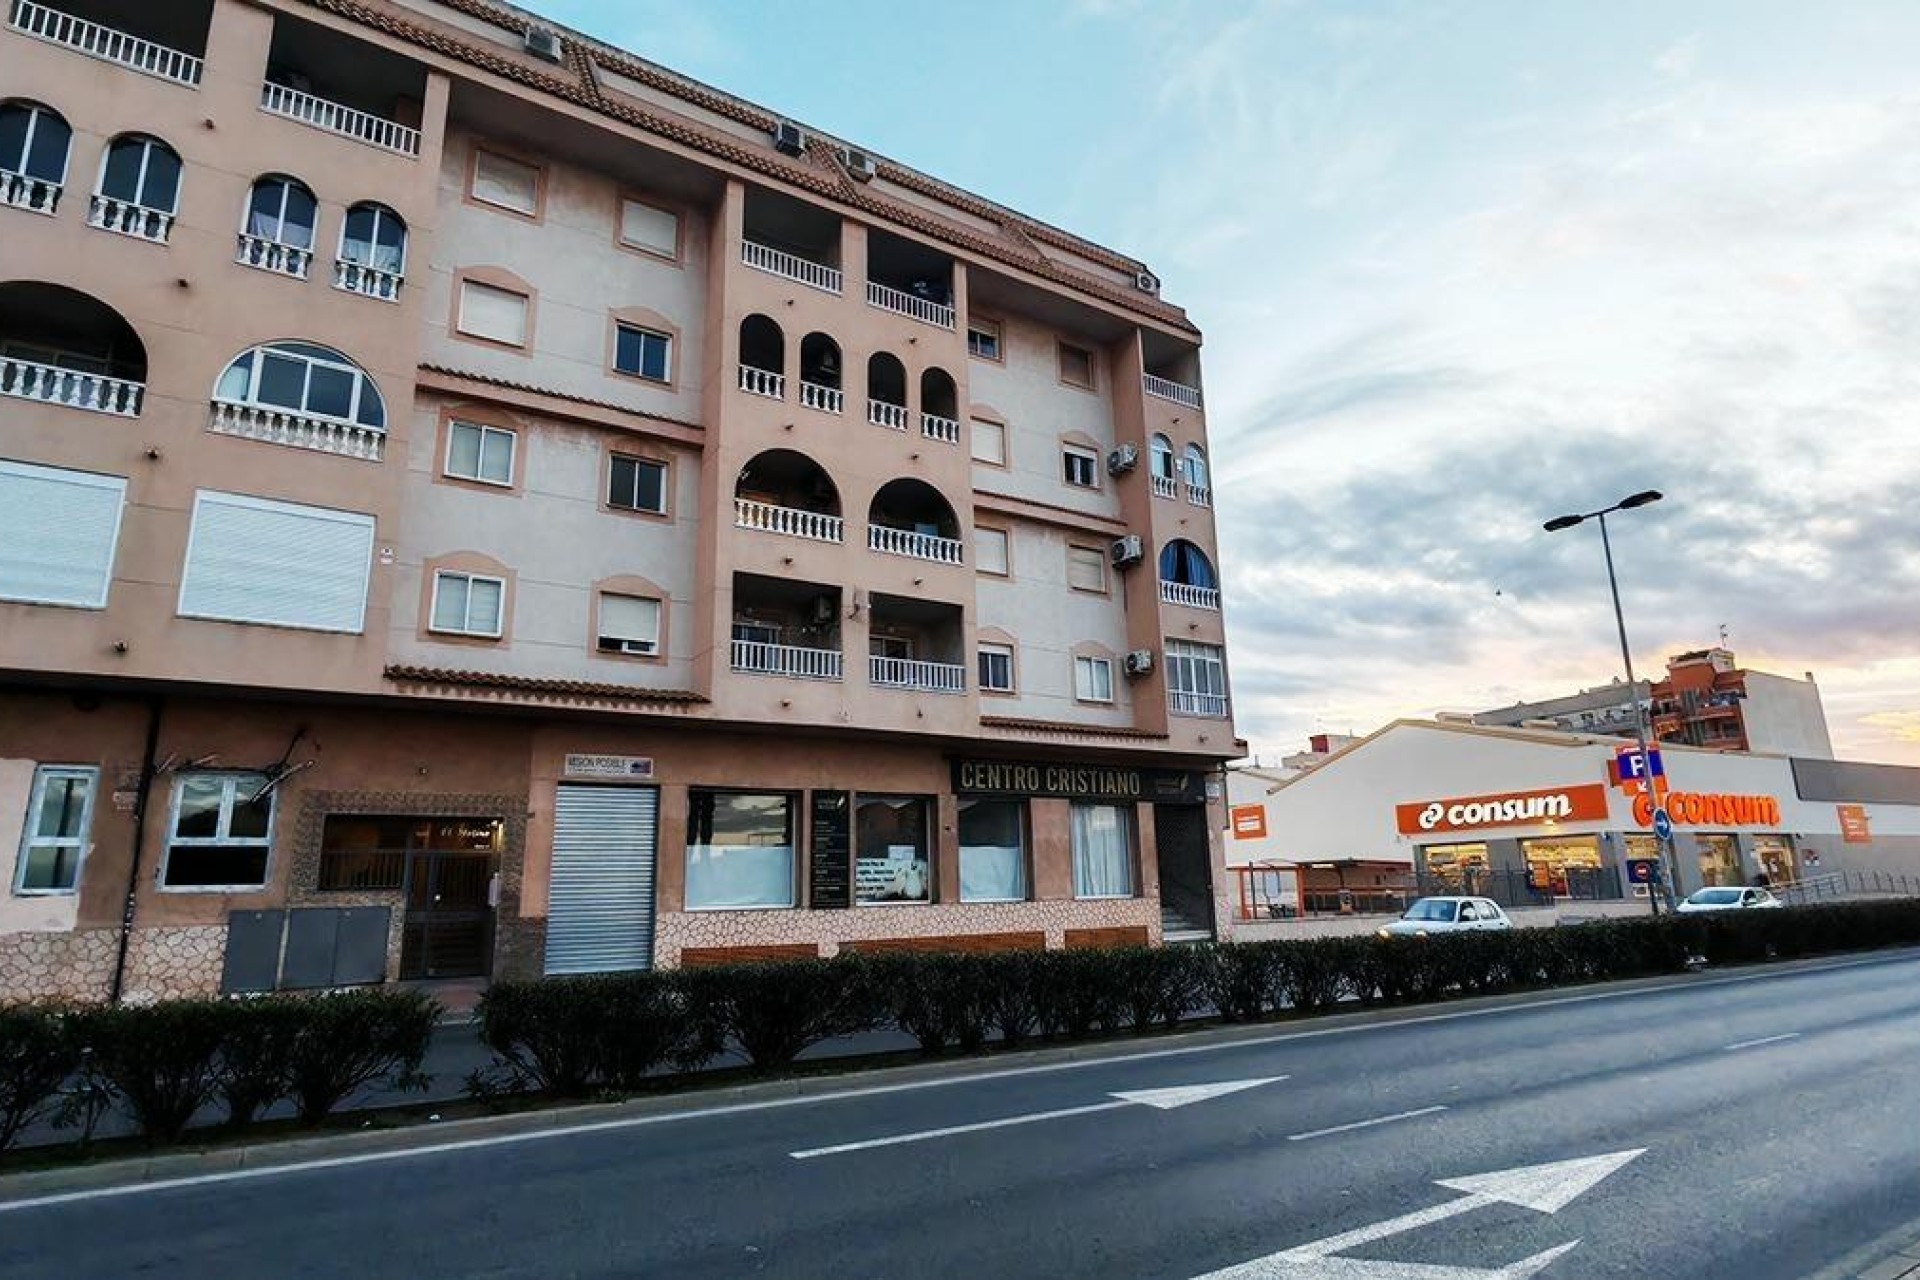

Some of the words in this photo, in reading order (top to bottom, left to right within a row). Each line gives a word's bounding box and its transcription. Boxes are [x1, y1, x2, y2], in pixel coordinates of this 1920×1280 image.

[961, 762, 1039, 791] CENTRO
[1046, 767, 1140, 795] CRISTIANO
[1447, 793, 1573, 826] consum
[1667, 791, 1780, 826] consum
